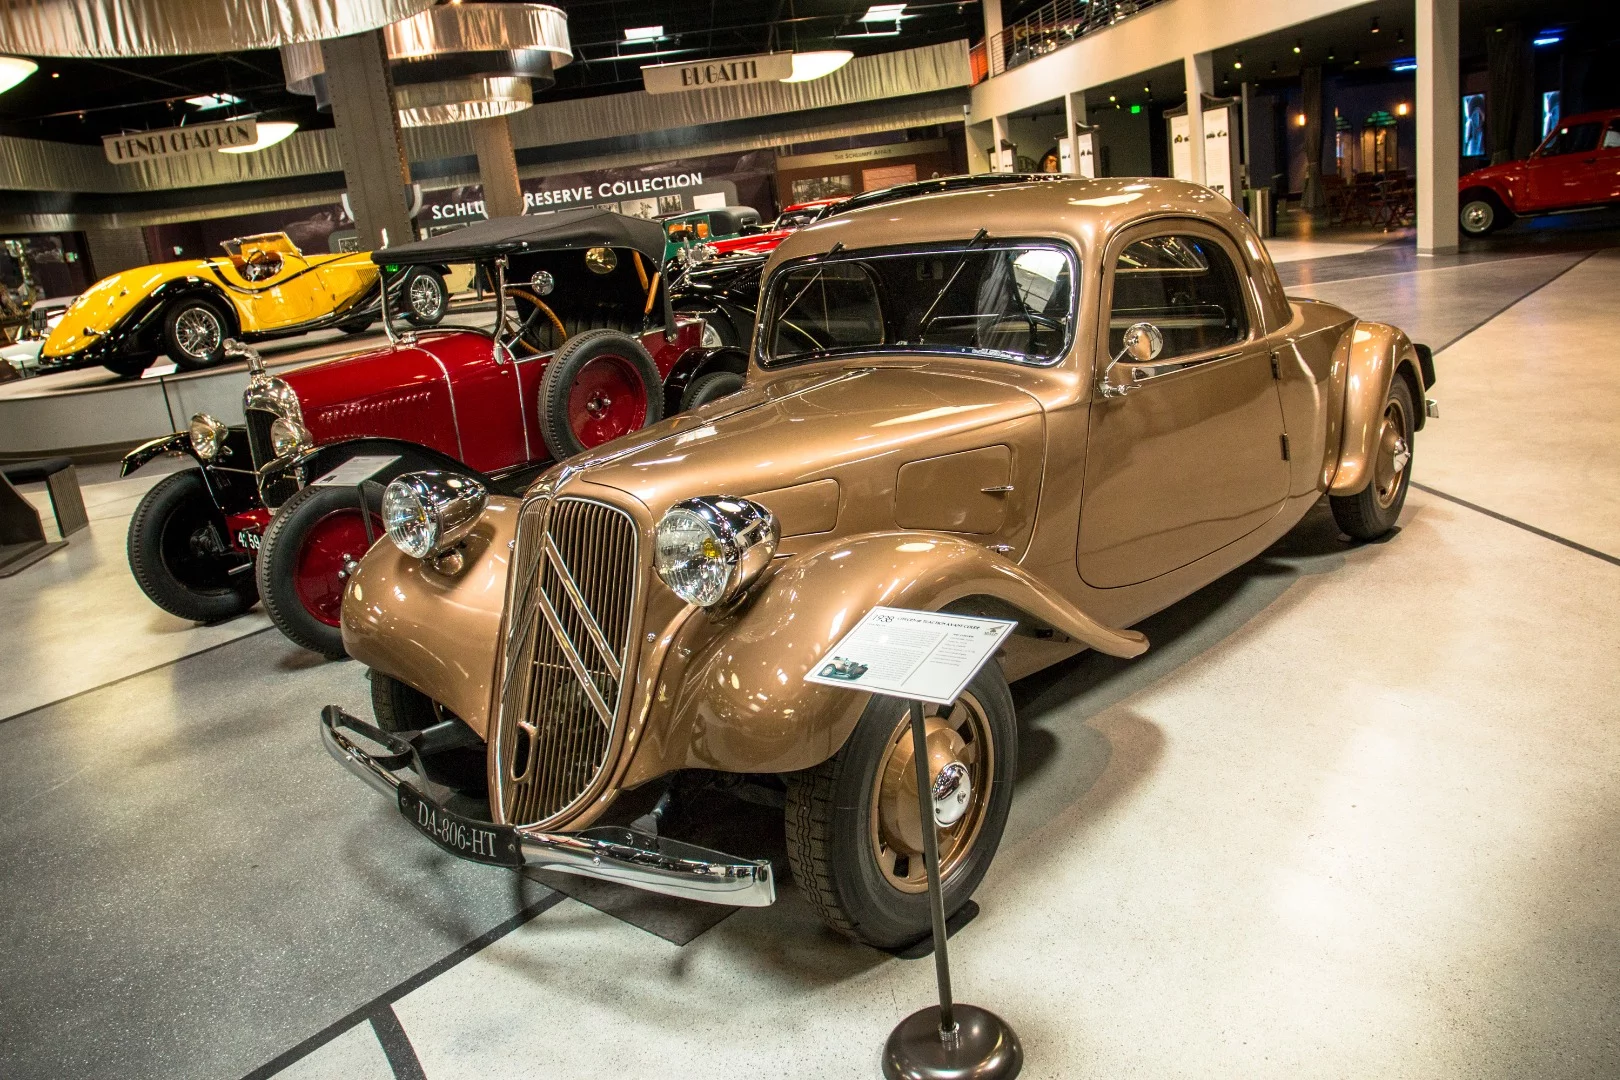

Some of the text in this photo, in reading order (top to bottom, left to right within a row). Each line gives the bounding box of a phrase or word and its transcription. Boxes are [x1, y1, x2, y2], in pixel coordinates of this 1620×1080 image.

[681, 60, 758, 86] BUGATTI
[115, 124, 250, 159] HENRI CHAPRON
[431, 172, 703, 220] SCHLU RESERVE COLLECTION
[873, 614, 895, 624] 1938
[417, 800, 497, 858] DA-806-HT
